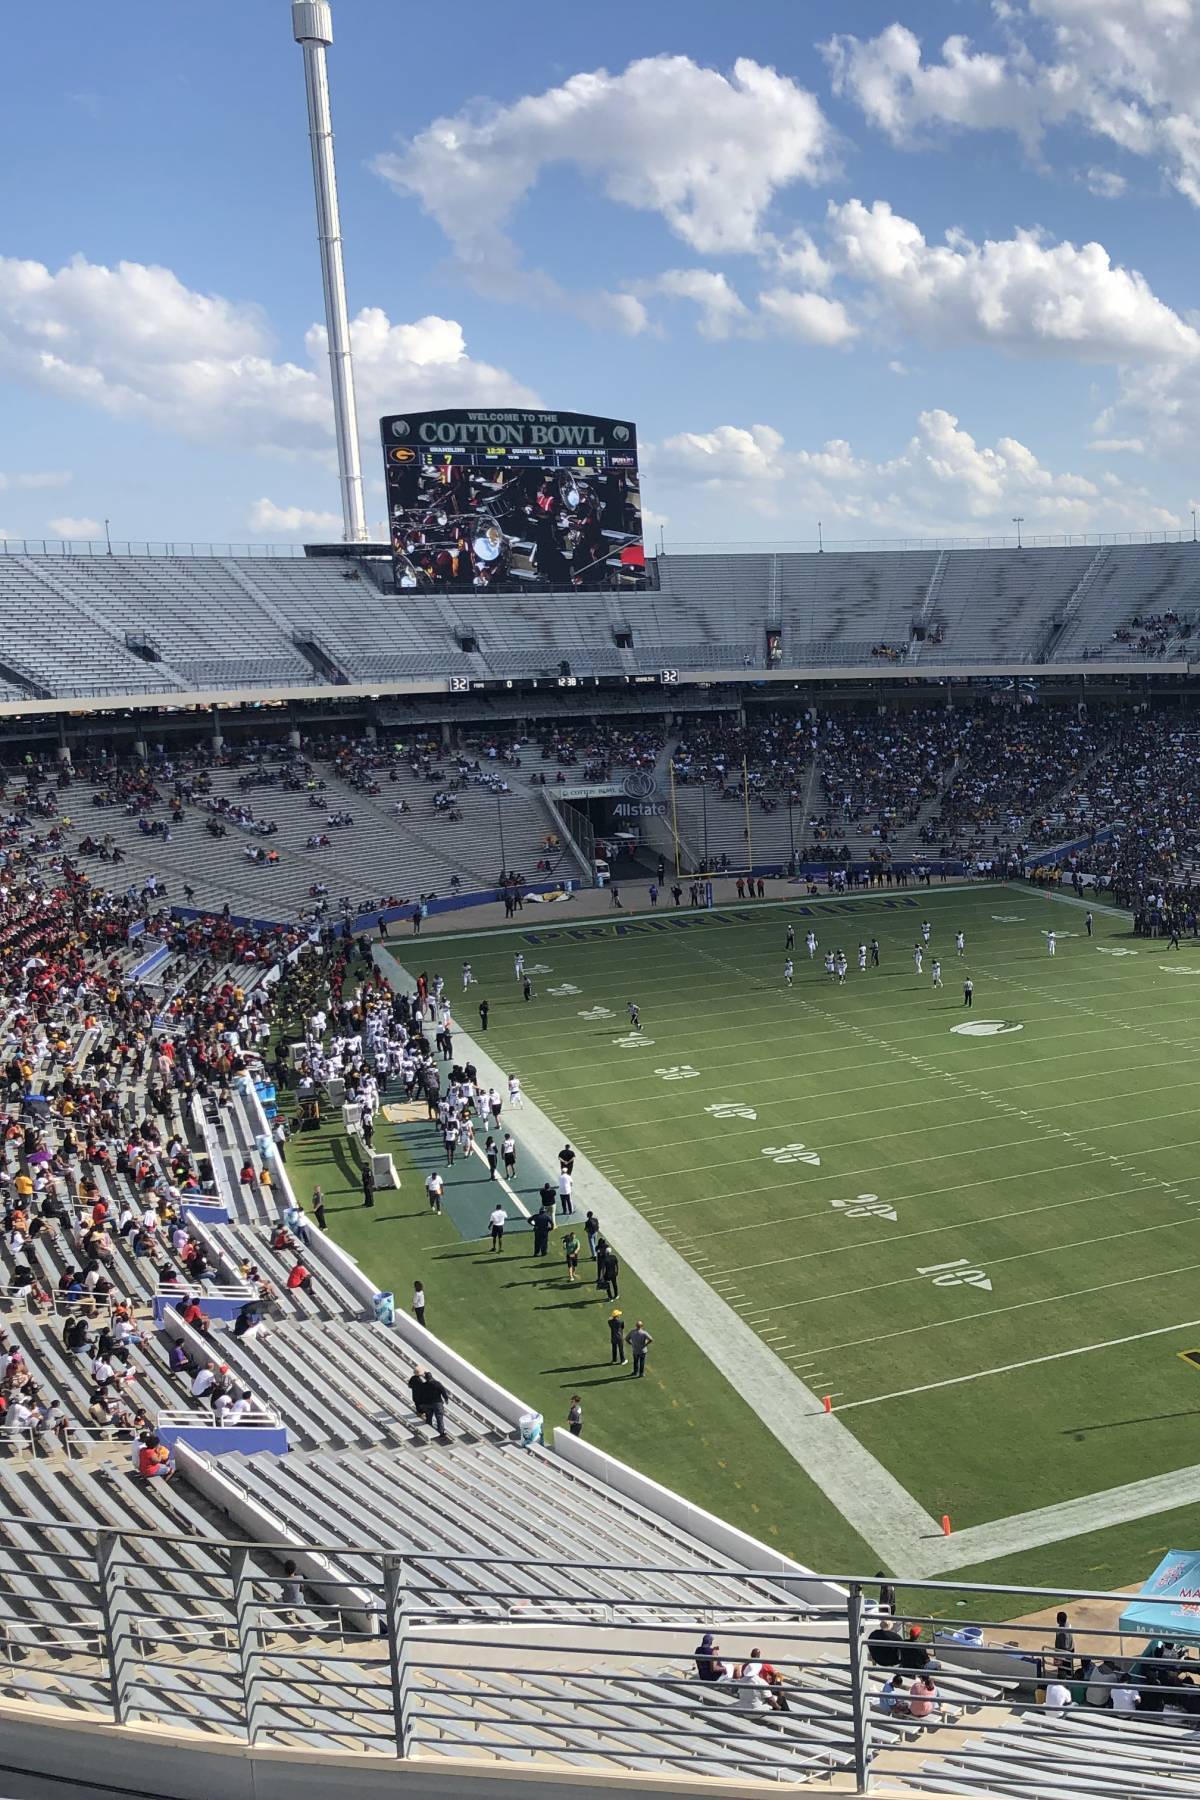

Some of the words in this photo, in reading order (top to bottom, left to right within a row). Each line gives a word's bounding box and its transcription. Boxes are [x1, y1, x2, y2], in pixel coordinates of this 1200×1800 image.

[467, 412, 519, 421] WELCOME
[523, 414, 535, 422] TO
[538, 414, 558, 422] THE
[419, 423, 524, 445] COTTON
[531, 425, 604, 446] BOWL
[444, 454, 452, 464] 7
[577, 457, 585, 466] 0
[663, 670, 677, 682] 32
[453, 678, 466, 690] 32
[612, 803, 666, 817] Allstate
[522, 908, 764, 946] PRAIRIE
[780, 897, 921, 919] VIEW
[654, 1065, 701, 1080] 50
[704, 1103, 755, 1118] 40
[761, 1143, 818, 1164] 30
[829, 1193, 894, 1218] 20
[916, 1258, 987, 1286] 10
